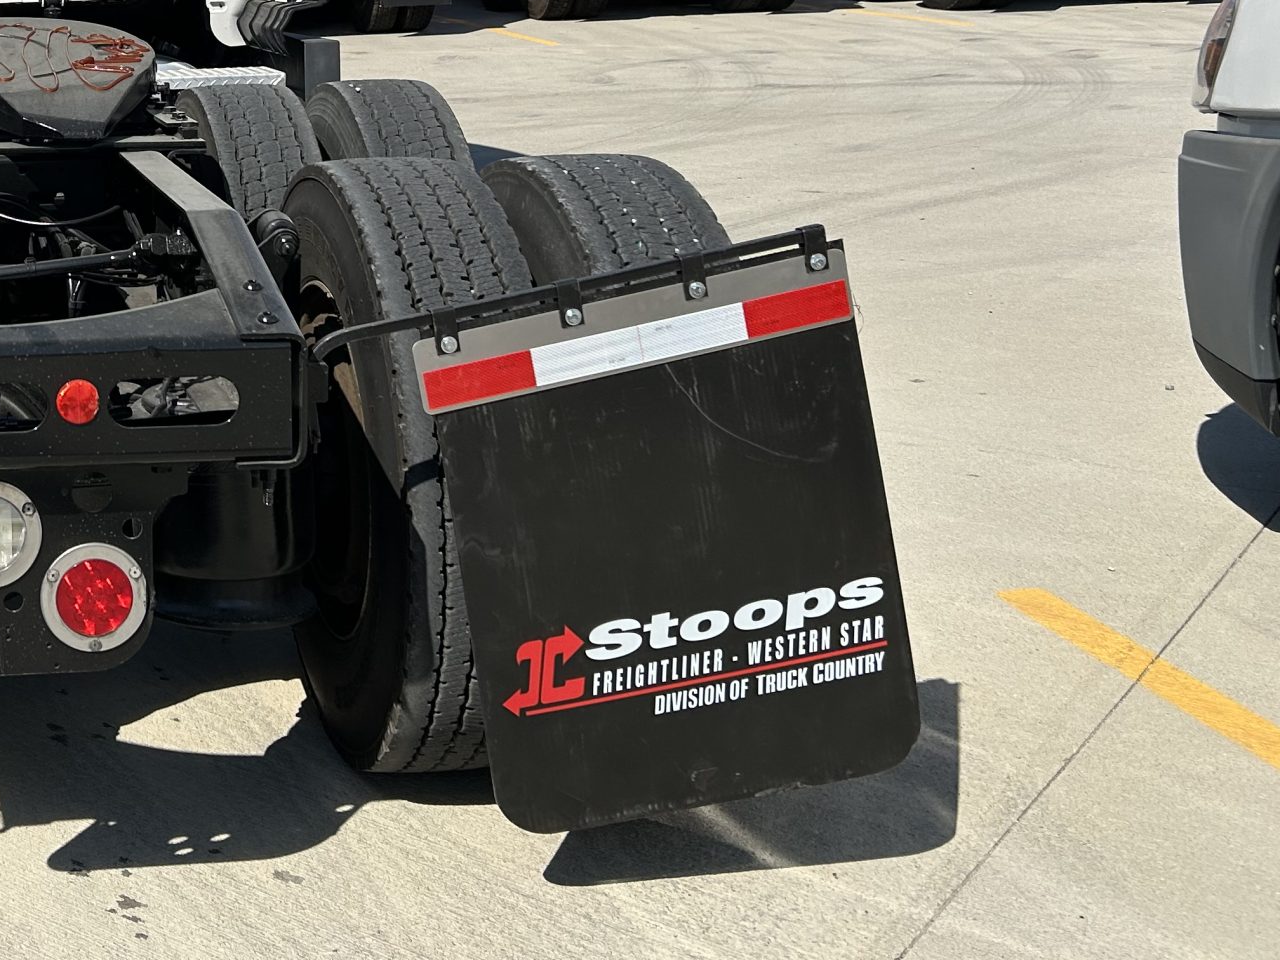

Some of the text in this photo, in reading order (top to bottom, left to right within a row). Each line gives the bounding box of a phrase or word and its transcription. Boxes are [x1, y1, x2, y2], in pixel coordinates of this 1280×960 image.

[585, 576, 884, 661] Stoops
[592, 648, 723, 696] FREIGHTLINER
[747, 626, 831, 666] WESTERN
[840, 615, 884, 647] STAR
[654, 651, 885, 716] DIVISION OF TRUCK COUNTRY
